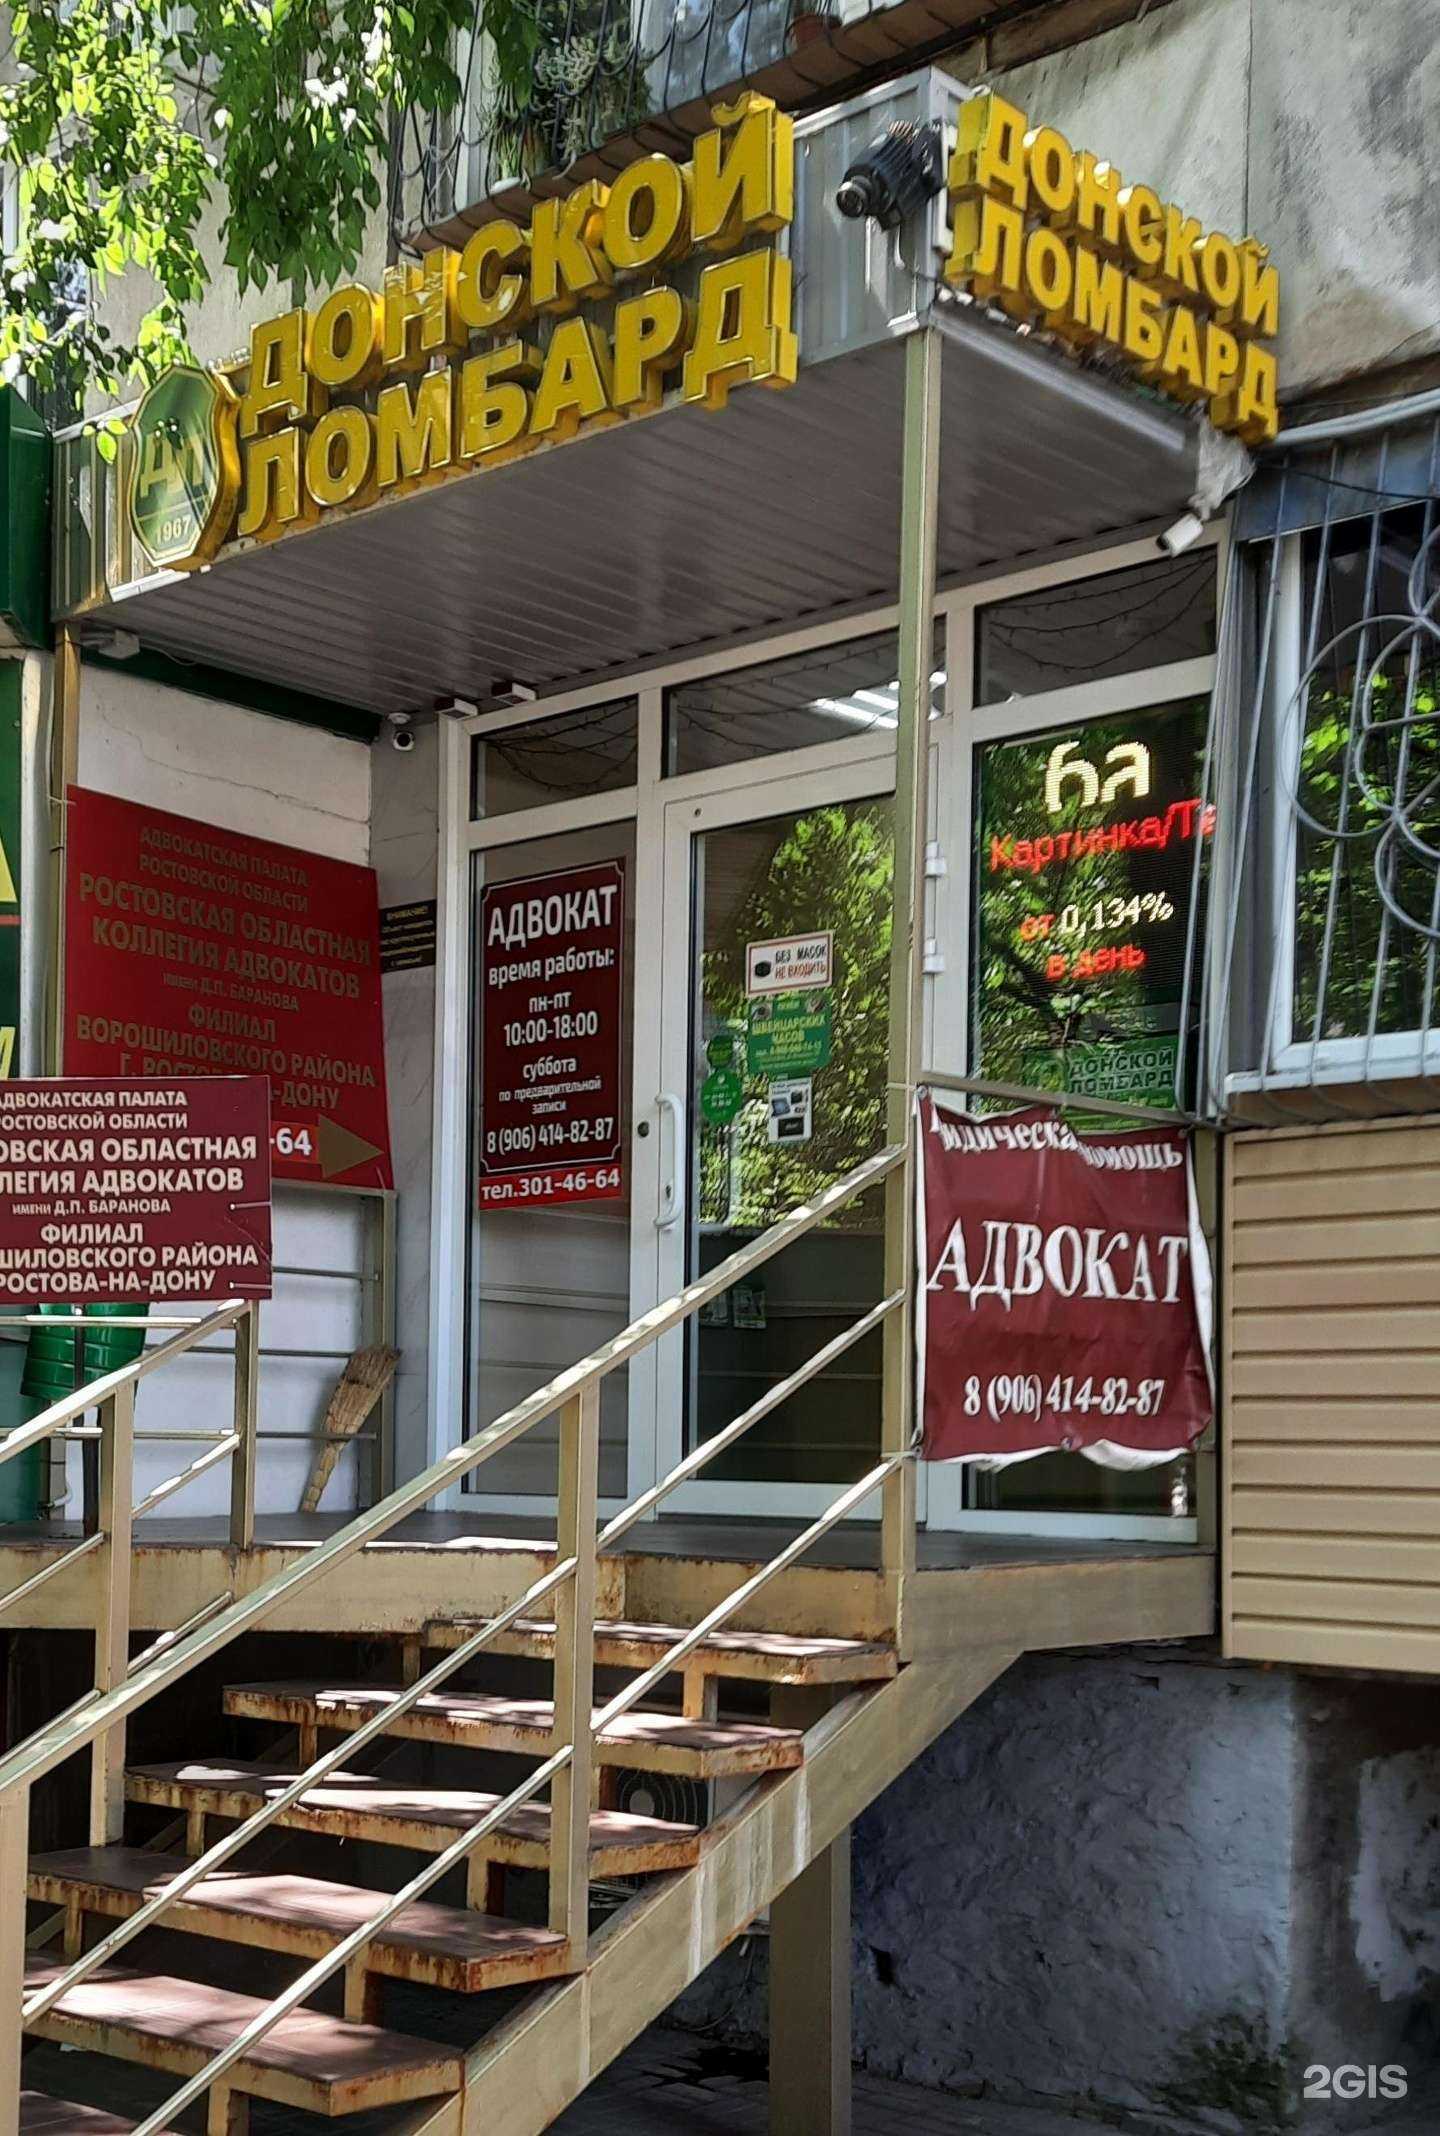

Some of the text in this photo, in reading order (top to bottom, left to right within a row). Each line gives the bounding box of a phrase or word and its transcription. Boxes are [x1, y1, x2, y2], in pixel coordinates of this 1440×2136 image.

[968, 92, 1280, 337] ДОНСКОЙ
[240, 92, 792, 438] ДОНСКОЙ
[966, 193, 1280, 438] ЛОМБАРД
[238, 248, 792, 537] ЛОМБАРД
[156, 515, 191, 543] 1967
[139, 826, 309, 887] АДВОКАТСКАЯ ПАЛАТА
[139, 853, 309, 913] РОСТОВСКОЙ ОБЛАСТИ
[80, 872, 234, 936] РОСТОВСКАЯ
[240, 912, 370, 966] ОБЛАСТНАЯ
[487, 884, 618, 952] АДВОКАТ
[1058, 891, 1174, 938] 0,134%
[93, 916, 360, 999] КОЛЛЕГИЯ АДВОКАТОВ
[488, 946, 615, 989] время работы:
[1071, 944, 1147, 978] день
[230, 982, 299, 1012] БАРАНОВА
[528, 991, 572, 1013] пн-пт
[188, 1002, 276, 1042] ФИЛИАЛ
[503, 1010, 598, 1047] 10:00-18:00
[77, 1014, 376, 1088] ВОРОШИЛОВСКОГО РАЙОНА
[522, 1055, 577, 1082] суббота
[1070, 1047, 1173, 1079] ДОНСКОЙ
[498, 1075, 601, 1102] по предварительной
[1070, 1070, 1173, 1094] ЛОМБАРД
[0, 1090, 188, 1111] ДВОКАТСКАЯ ПАЛАТА
[531, 1100, 567, 1115] записи
[0, 1110, 188, 1131] ОСТОВСКОЙ ОБЛАСТИ
[486, 1117, 614, 1155] 8 (906) 414-82-87
[100, 1135, 258, 1163] ОБЛАСТНАЯ
[81, 1166, 245, 1197] АДВОКАТОВ
[481, 1168, 620, 1200] тел.301-46-64
[53, 1199, 86, 1217] Д.П.
[88, 1198, 171, 1215] БАРАНОВА
[40, 1222, 144, 1245] ФИЛИАЛ
[161, 1241, 259, 1267] РАЙОНА
[926, 1216, 1188, 1313] АДВОКАТ
[963, 1373, 1166, 1423] 8 (906) 414-82-87
